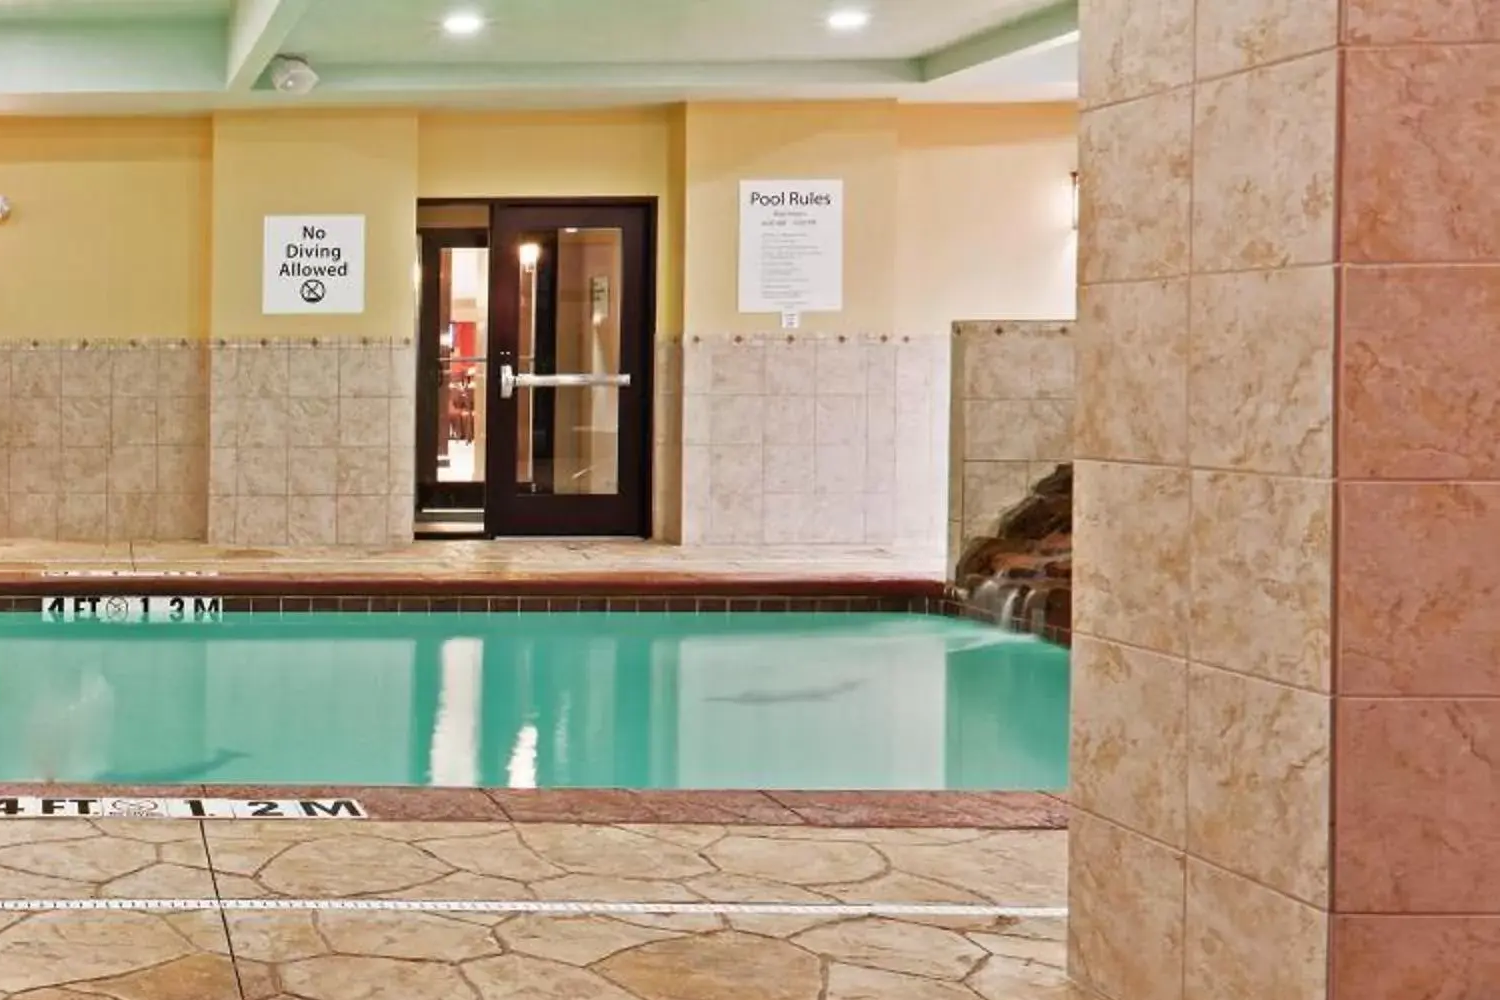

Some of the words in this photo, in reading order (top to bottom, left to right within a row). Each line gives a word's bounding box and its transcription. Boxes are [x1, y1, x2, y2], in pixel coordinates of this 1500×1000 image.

[750, 191, 785, 206] Pool
[789, 191, 832, 206] Rules
[302, 225, 326, 240] No
[286, 244, 341, 261] Diving
[279, 262, 348, 277] Allowed
